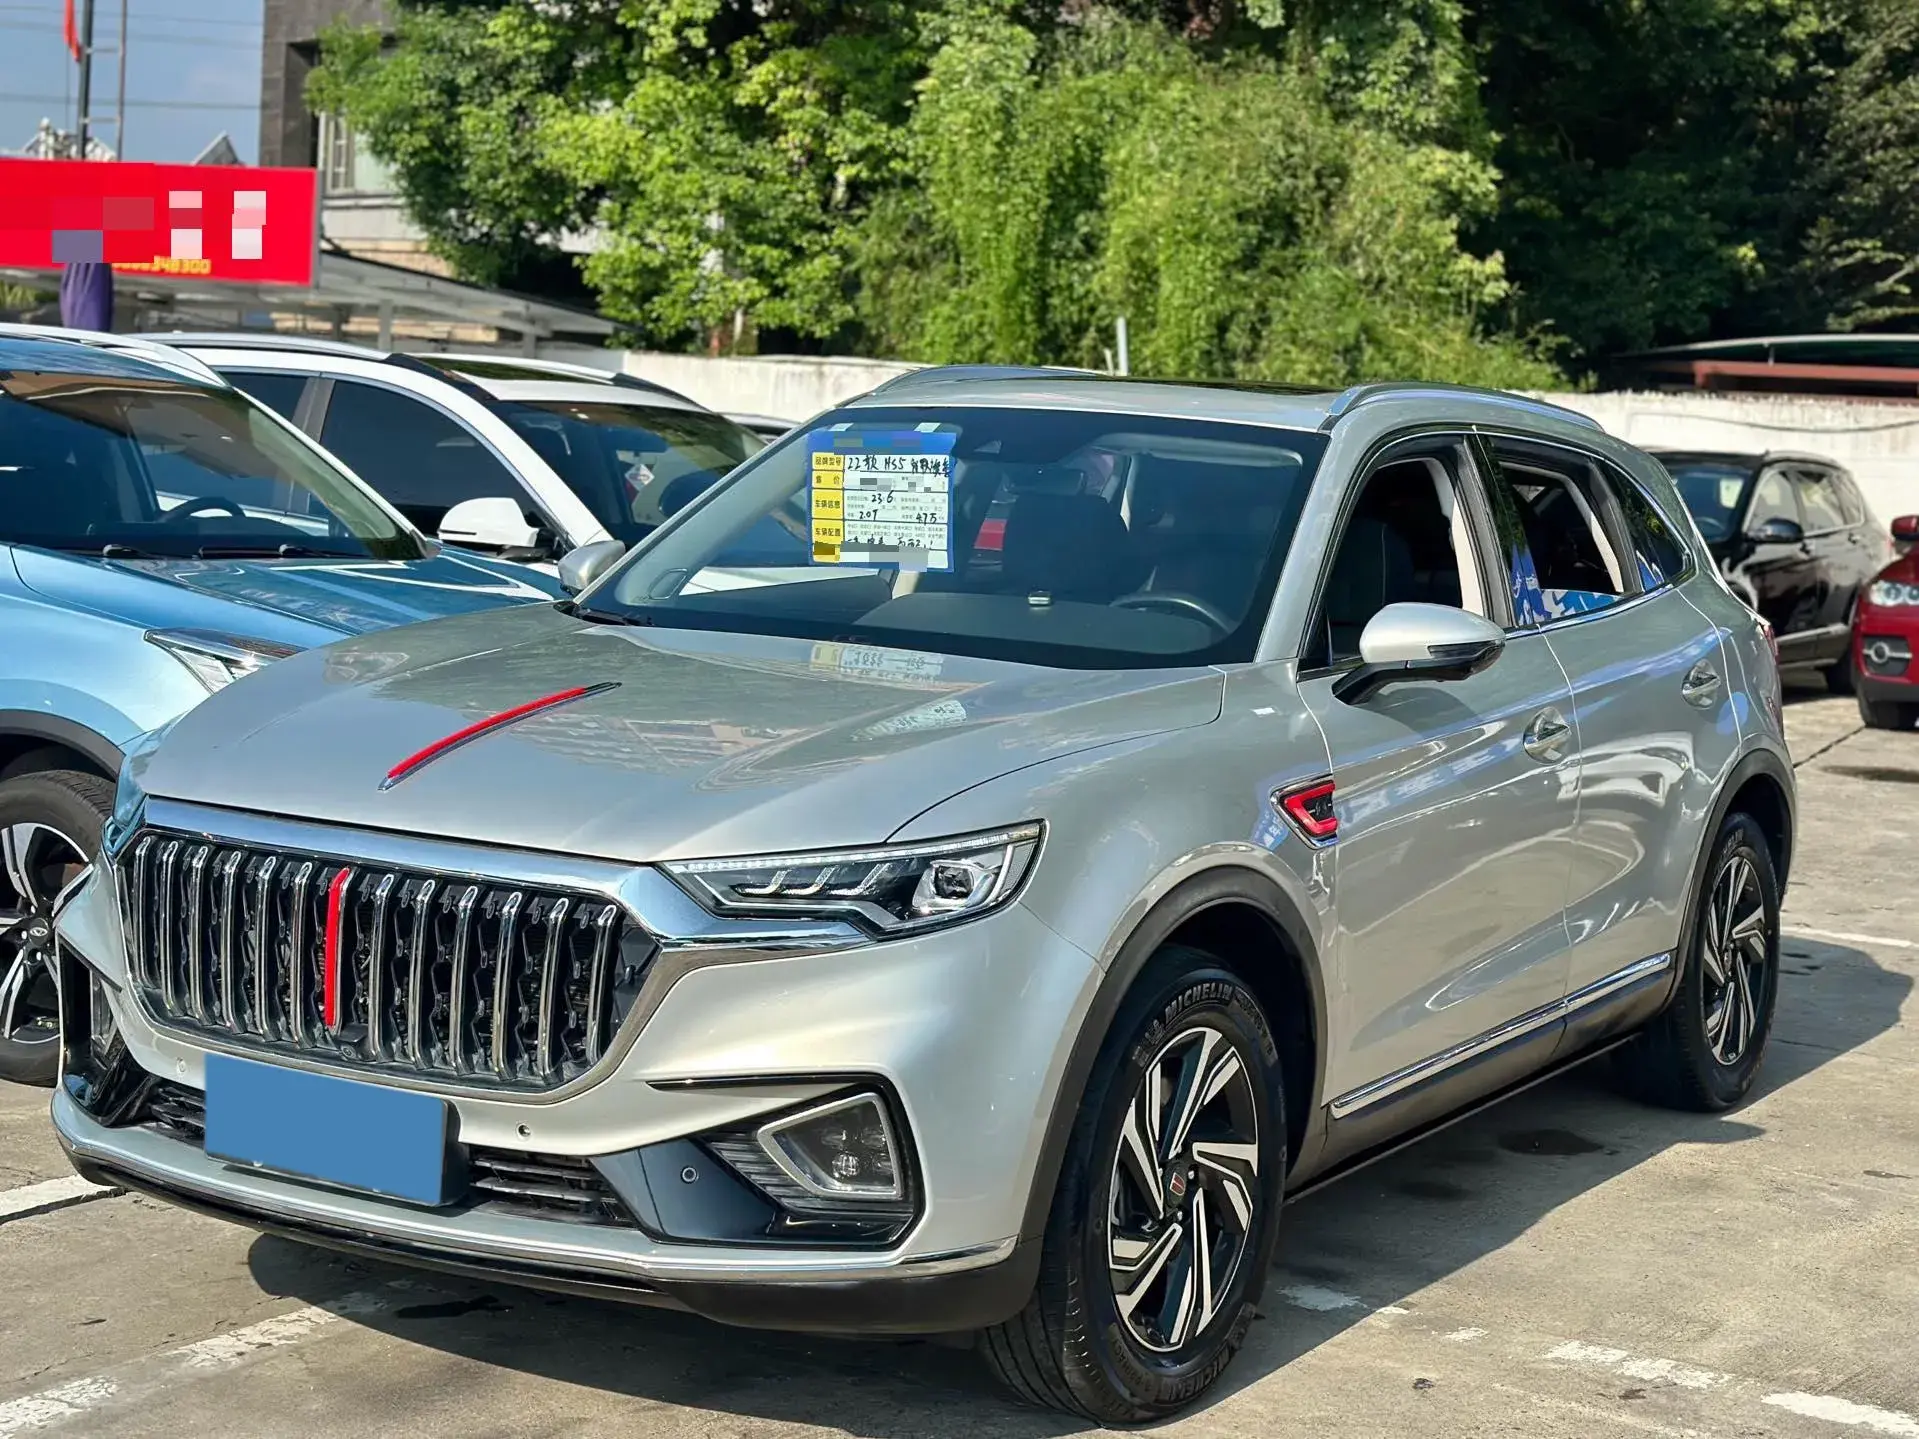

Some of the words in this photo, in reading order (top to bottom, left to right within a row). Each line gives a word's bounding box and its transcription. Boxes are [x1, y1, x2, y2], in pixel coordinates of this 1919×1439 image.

[815, 456, 841, 466] 品牌型号
[815, 499, 841, 508] 车辆信息
[815, 527, 841, 537] 车辆配置
[1164, 982, 1233, 1023] MICHELIN
